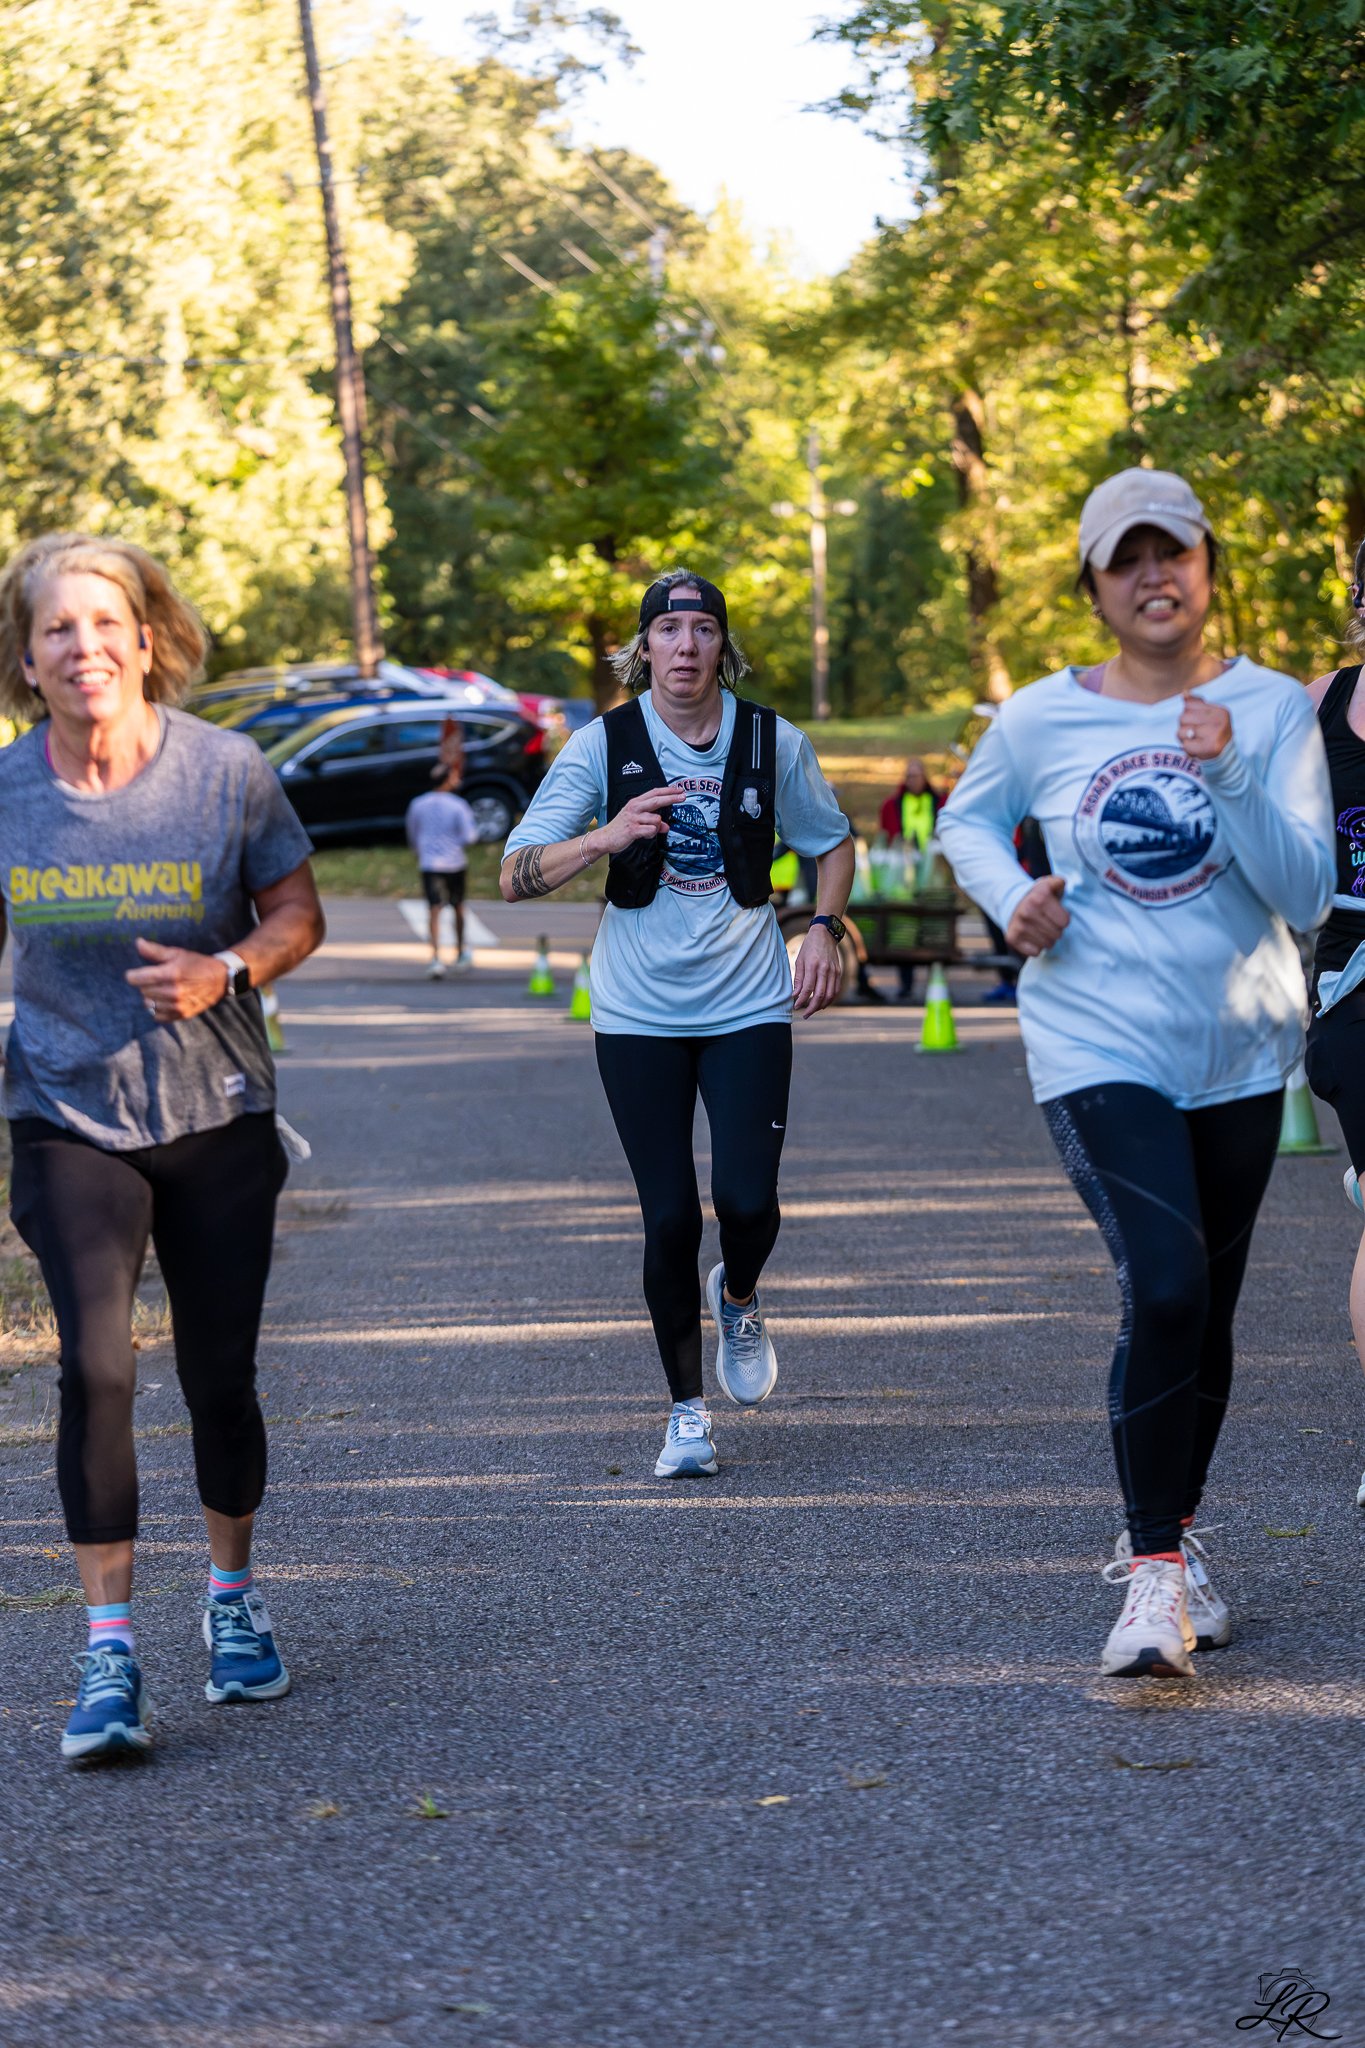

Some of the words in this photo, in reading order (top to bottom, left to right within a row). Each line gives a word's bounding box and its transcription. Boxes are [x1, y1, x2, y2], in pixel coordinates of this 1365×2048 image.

[697, 779, 721, 795] SER
[1081, 774, 1112, 817] ROAD
[1109, 754, 1149, 780] RACE
[1151, 752, 1203, 778] SERIES
[9, 861, 202, 905] Breakaway
[698, 876, 726, 891] MEMOR
